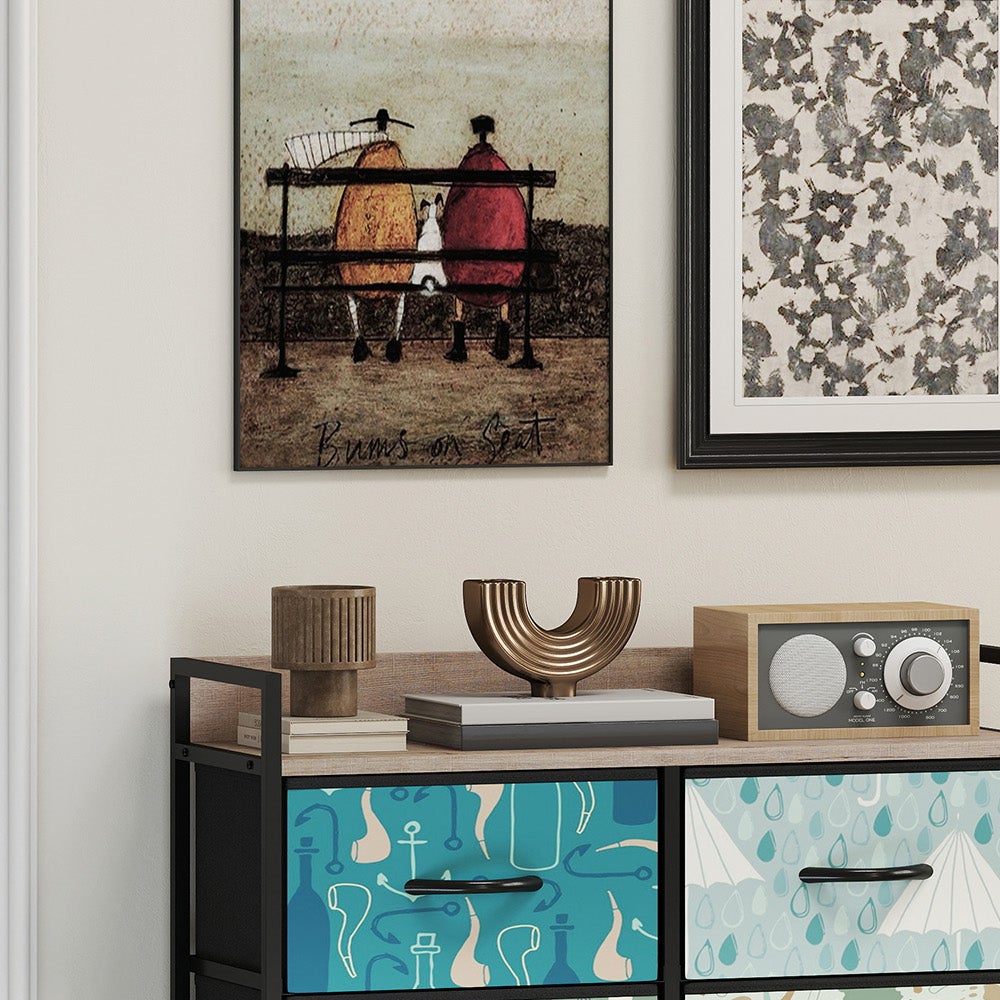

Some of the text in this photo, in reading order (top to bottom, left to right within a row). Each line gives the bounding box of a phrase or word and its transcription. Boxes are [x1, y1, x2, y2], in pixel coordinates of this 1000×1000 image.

[313, 410, 557, 467] Bums on Seat
